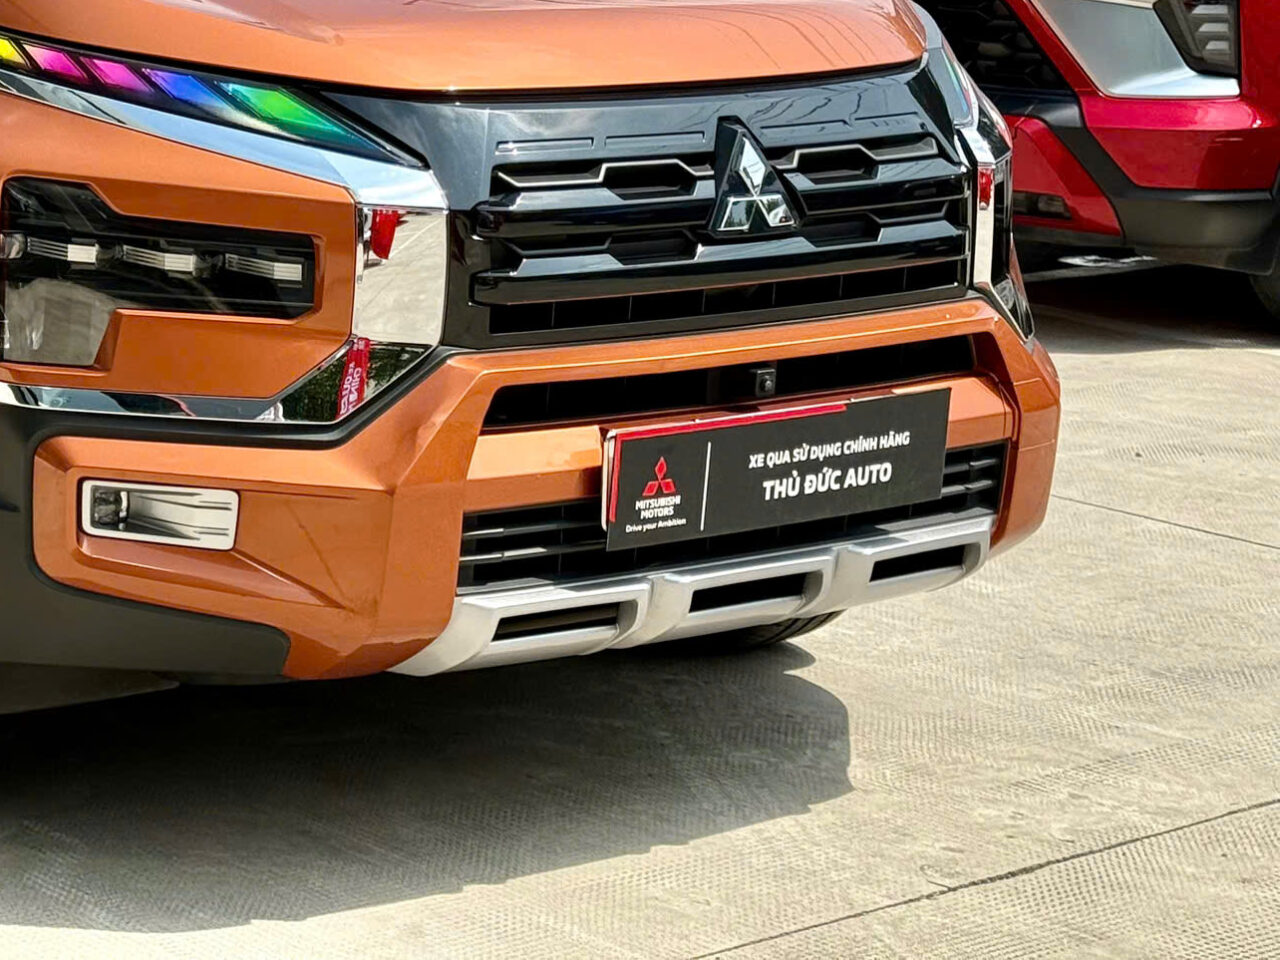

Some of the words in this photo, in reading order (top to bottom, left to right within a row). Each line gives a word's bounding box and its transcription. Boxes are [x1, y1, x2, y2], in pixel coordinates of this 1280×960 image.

[749, 452, 765, 469] XE
[767, 450, 791, 468] QUA
[793, 443, 809, 462] SỬ
[810, 441, 841, 464] DỤNG
[843, 435, 877, 454] CHÍNH
[880, 431, 910, 450] HÃNG
[762, 469, 800, 501] THỦ
[804, 462, 840, 496] ĐỨC
[843, 462, 892, 489] AUTO
[635, 495, 681, 510] MITSUBISHI
[640, 506, 675, 520] MOTORS
[625, 524, 643, 533] Drive
[643, 522, 657, 532] your
[657, 518, 687, 529] Ambition
